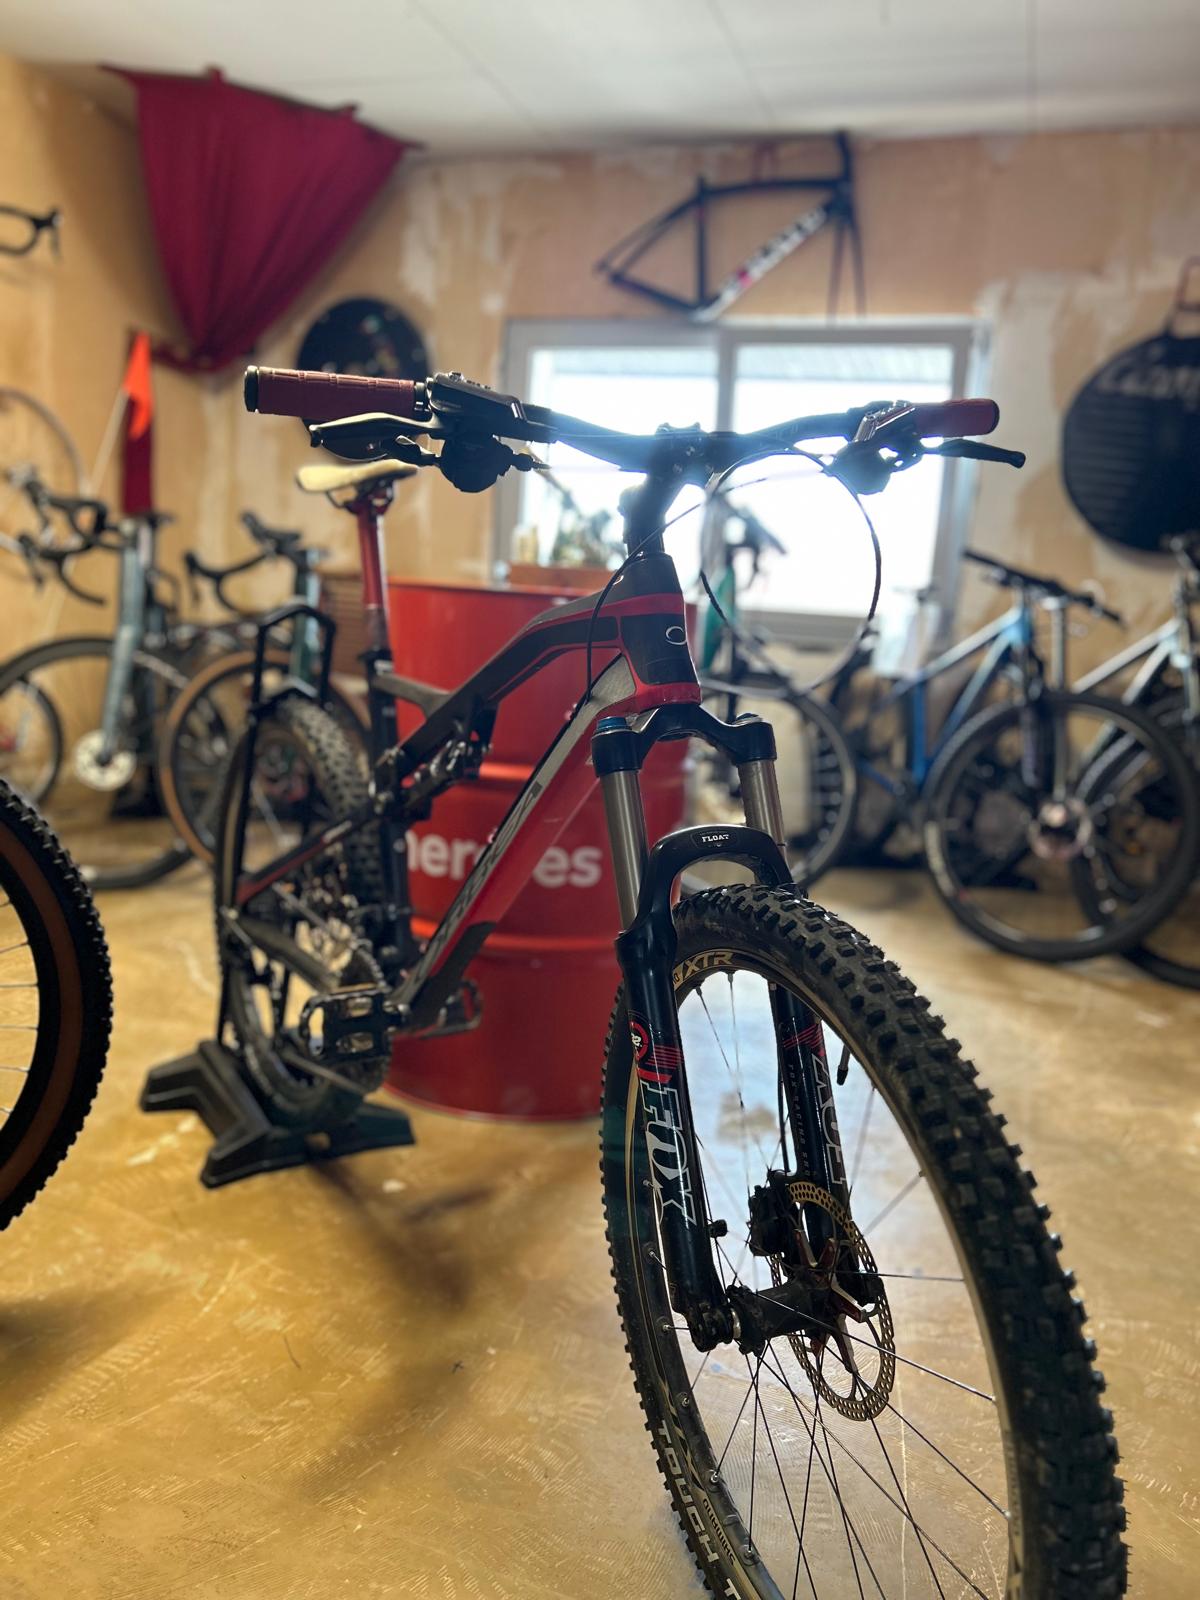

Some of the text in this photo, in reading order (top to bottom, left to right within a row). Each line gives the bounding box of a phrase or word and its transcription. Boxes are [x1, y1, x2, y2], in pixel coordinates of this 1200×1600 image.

[701, 833, 731, 844] FLOAT
[683, 951, 734, 978] XTR
[658, 1419, 720, 1563] TOUGH
[703, 1498, 736, 1566] SHIMANO
